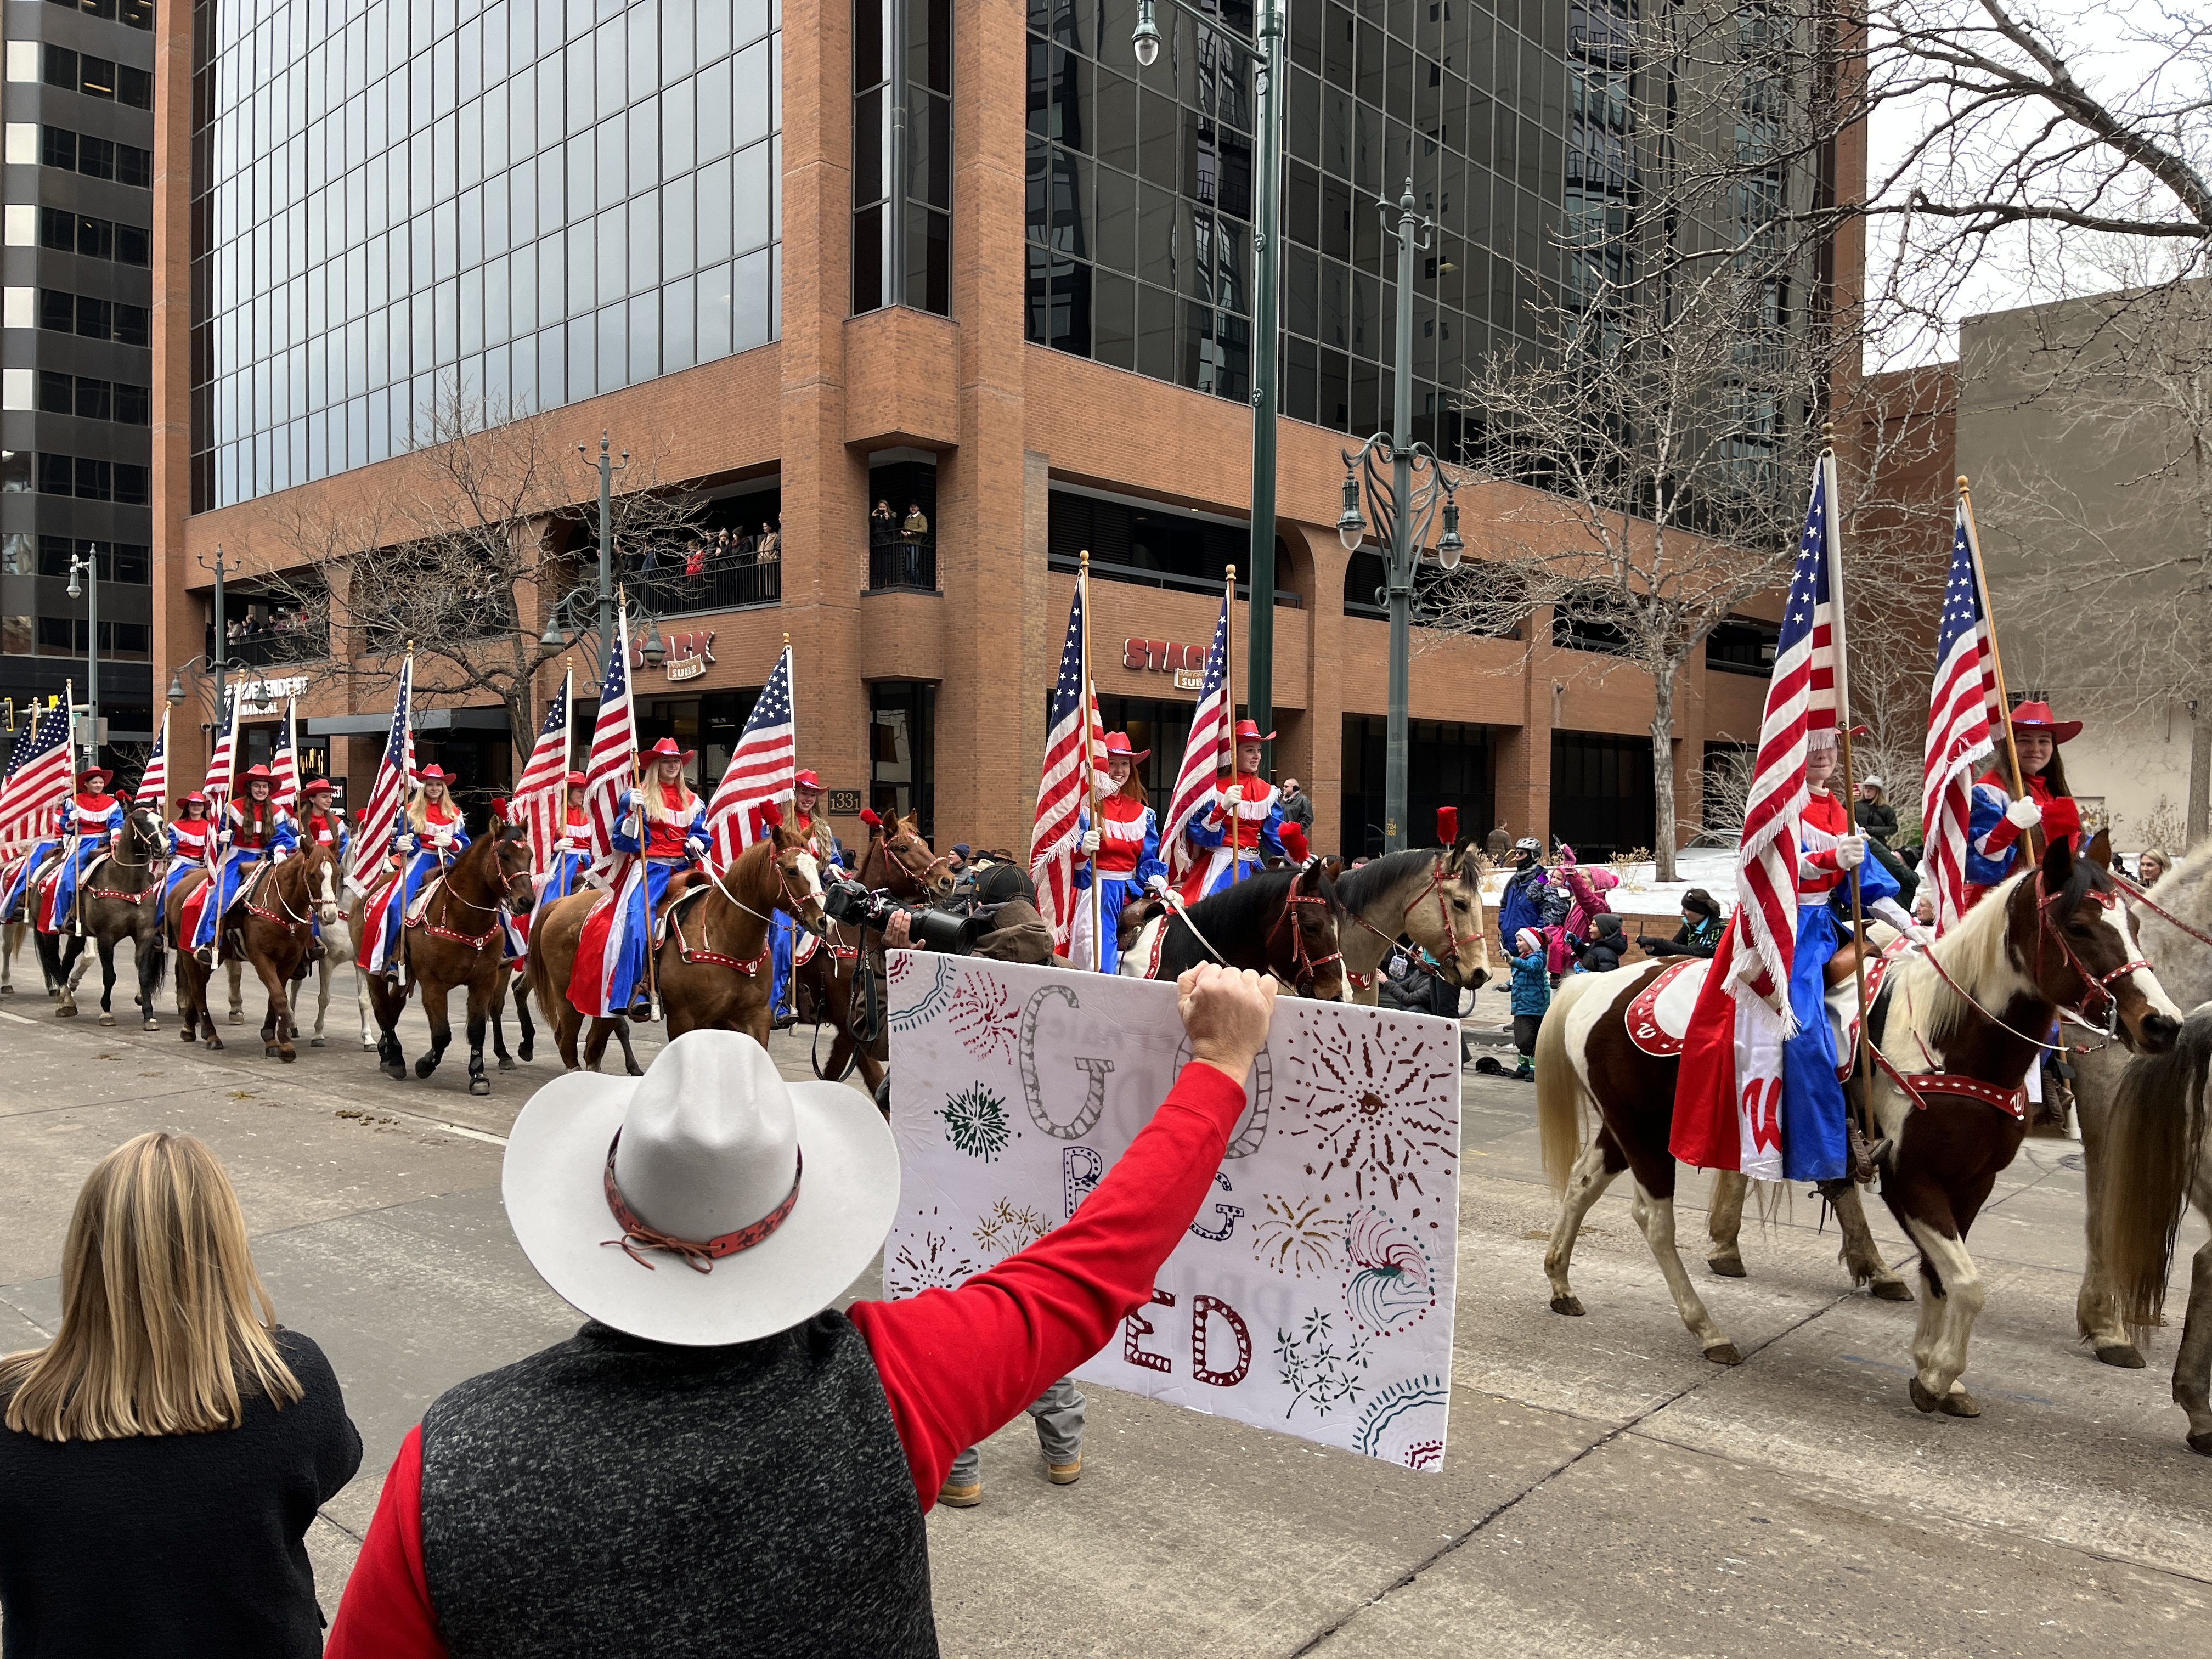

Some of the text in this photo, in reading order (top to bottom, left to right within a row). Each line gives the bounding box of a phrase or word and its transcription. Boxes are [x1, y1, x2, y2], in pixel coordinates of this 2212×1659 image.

[1123, 638, 1211, 673] STAC
[672, 664, 697, 678] SUBS
[1182, 677, 1203, 687] SUB
[830, 792, 860, 810] 1331
[1063, 1146, 1245, 1242] BG
[1124, 1288, 1252, 1387] ED
